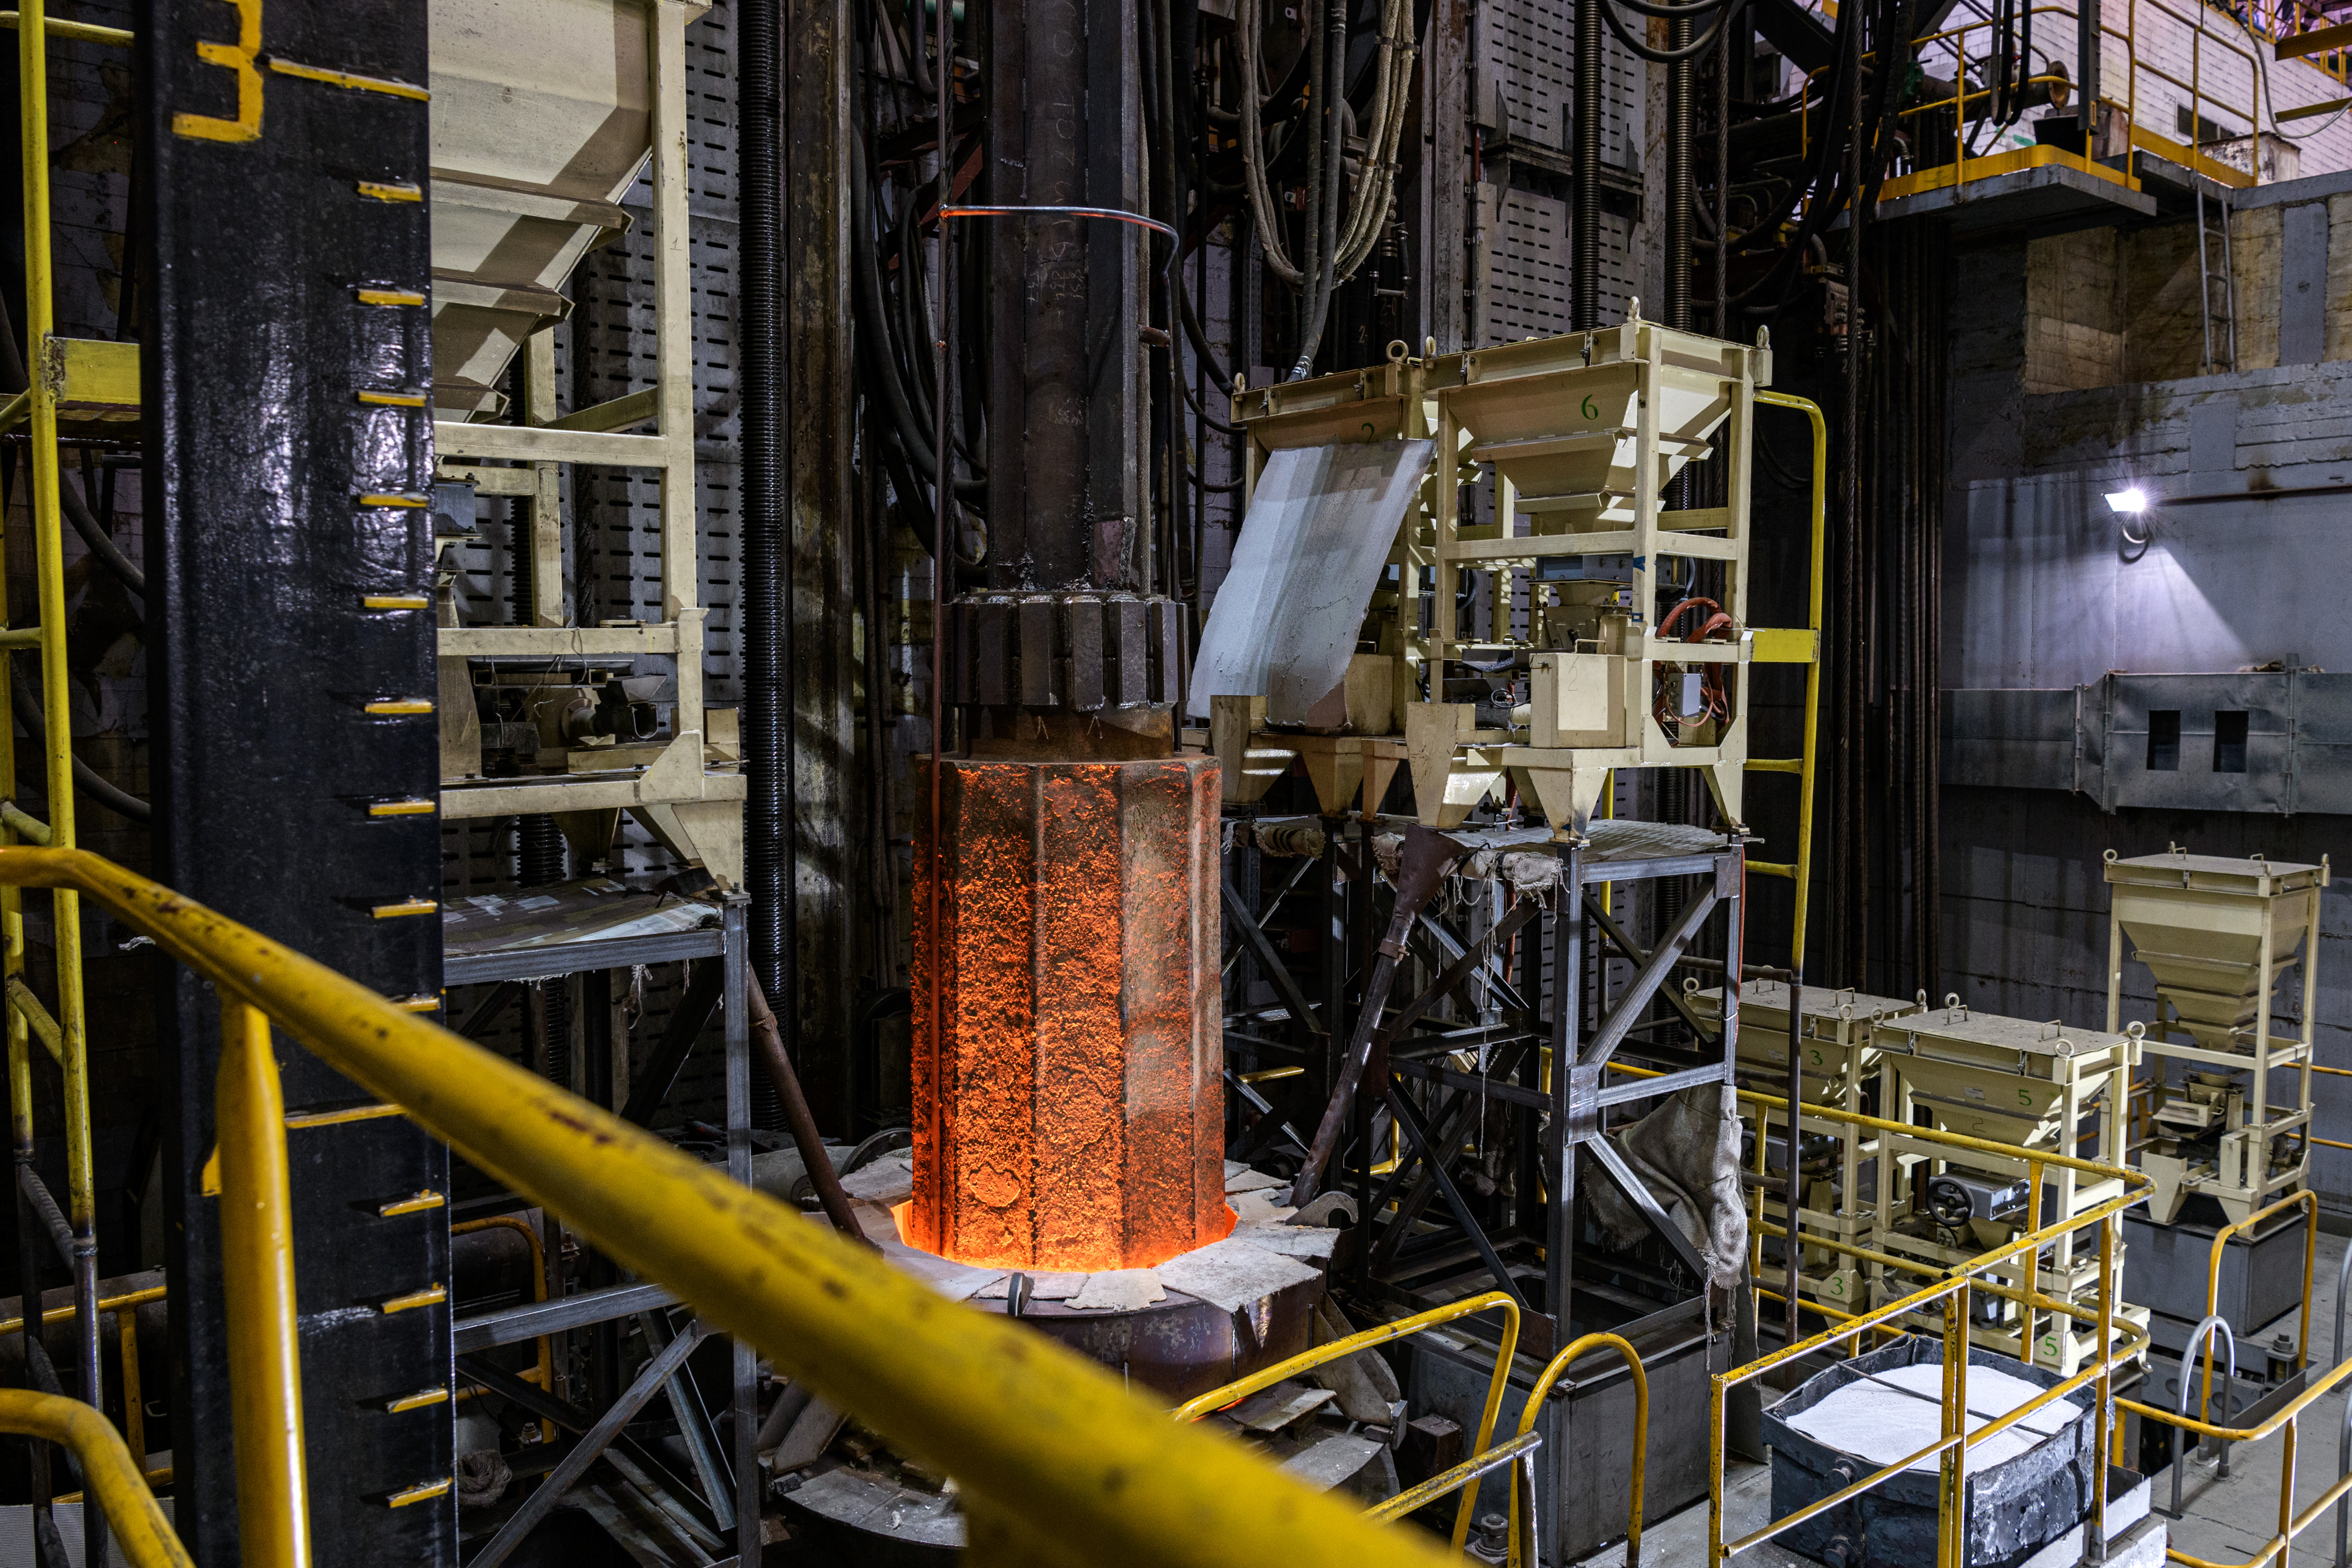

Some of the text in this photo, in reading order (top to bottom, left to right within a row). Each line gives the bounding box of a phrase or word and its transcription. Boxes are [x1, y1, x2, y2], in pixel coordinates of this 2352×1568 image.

[172, 0, 264, 144] 3
[670, 237, 682, 251] 1
[1581, 394, 1599, 420] 6
[1361, 422, 1379, 444] 2
[1810, 1050, 1823, 1066] 3
[2018, 1089, 2033, 1106] 5
[1830, 1277, 1843, 1296] 3
[2043, 1336, 2058, 1357] 5
